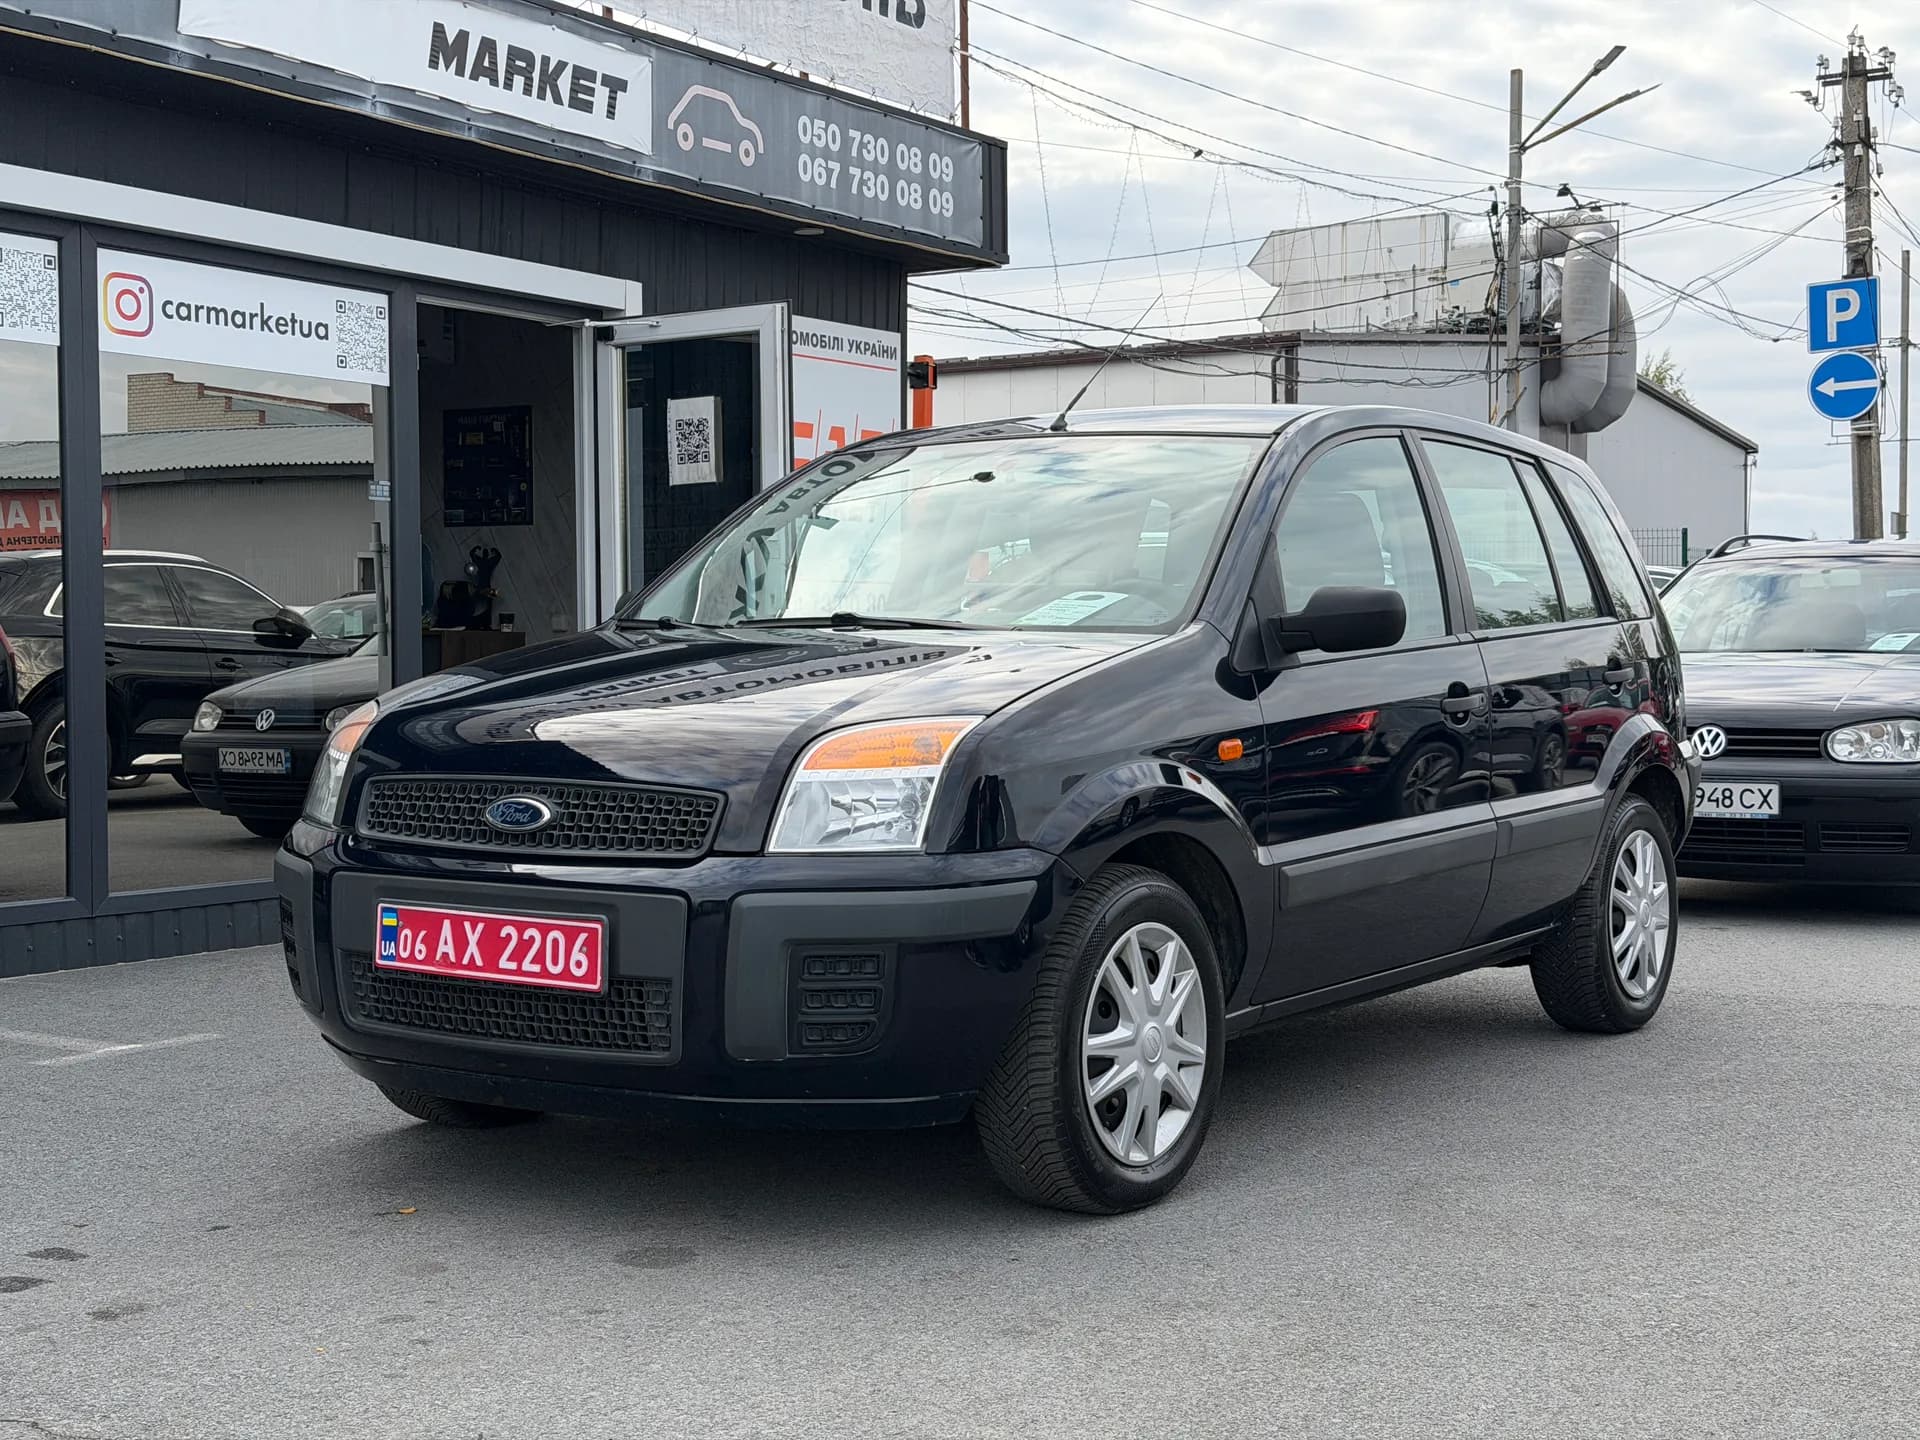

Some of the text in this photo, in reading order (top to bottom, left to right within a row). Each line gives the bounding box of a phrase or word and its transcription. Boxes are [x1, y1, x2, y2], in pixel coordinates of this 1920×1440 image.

[428, 21, 628, 120] MARKET
[798, 115, 954, 182] 050 730 08 09
[798, 153, 954, 219] 067 730 08 09
[161, 299, 329, 341] carmarketua
[1826, 288, 1860, 342] P
[848, 339, 897, 361] УКРАЇНИ
[499, 803, 534, 823] Ford
[1740, 788, 1773, 810] CX
[381, 919, 589, 977] UA 06 AX 2206
